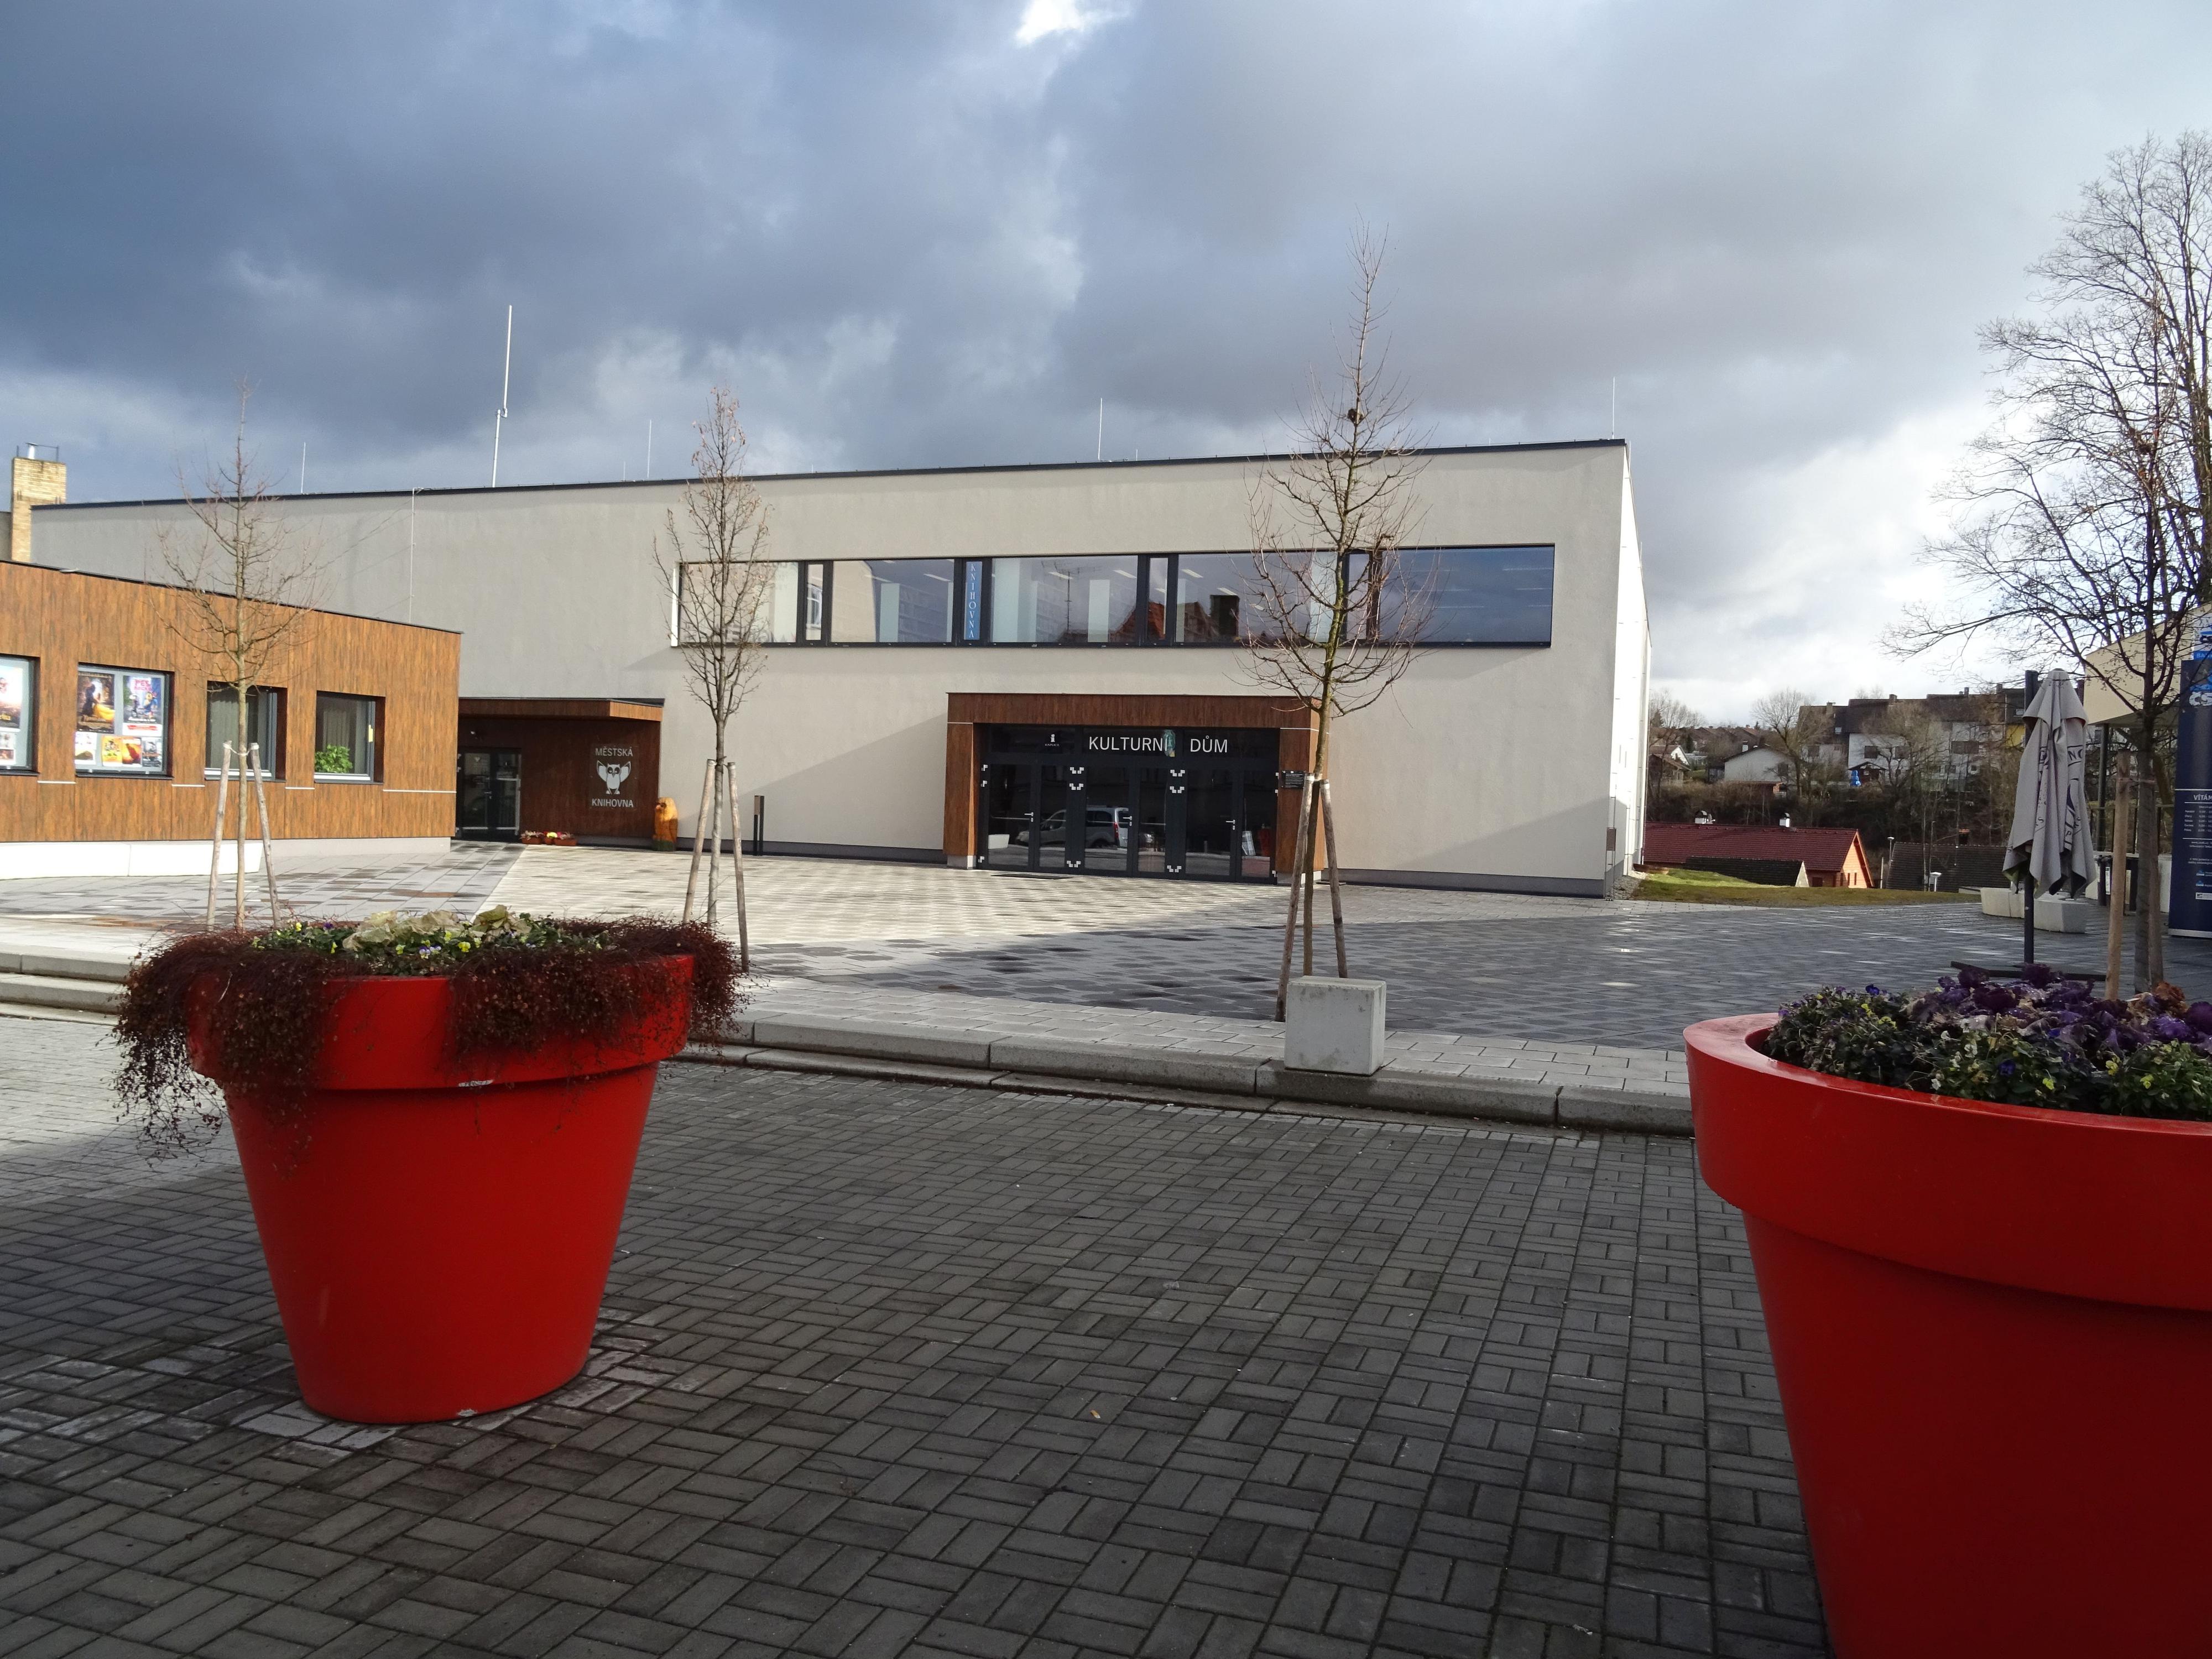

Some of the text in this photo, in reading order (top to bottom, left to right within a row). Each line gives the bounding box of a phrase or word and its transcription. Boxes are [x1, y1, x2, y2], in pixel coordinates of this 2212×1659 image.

[968, 564, 977, 638] KNIHOVNA
[1190, 735, 1228, 753] DŮM
[596, 747, 633, 757] MĚSTSKÁ
[592, 798, 634, 807] KNIHOVNA
